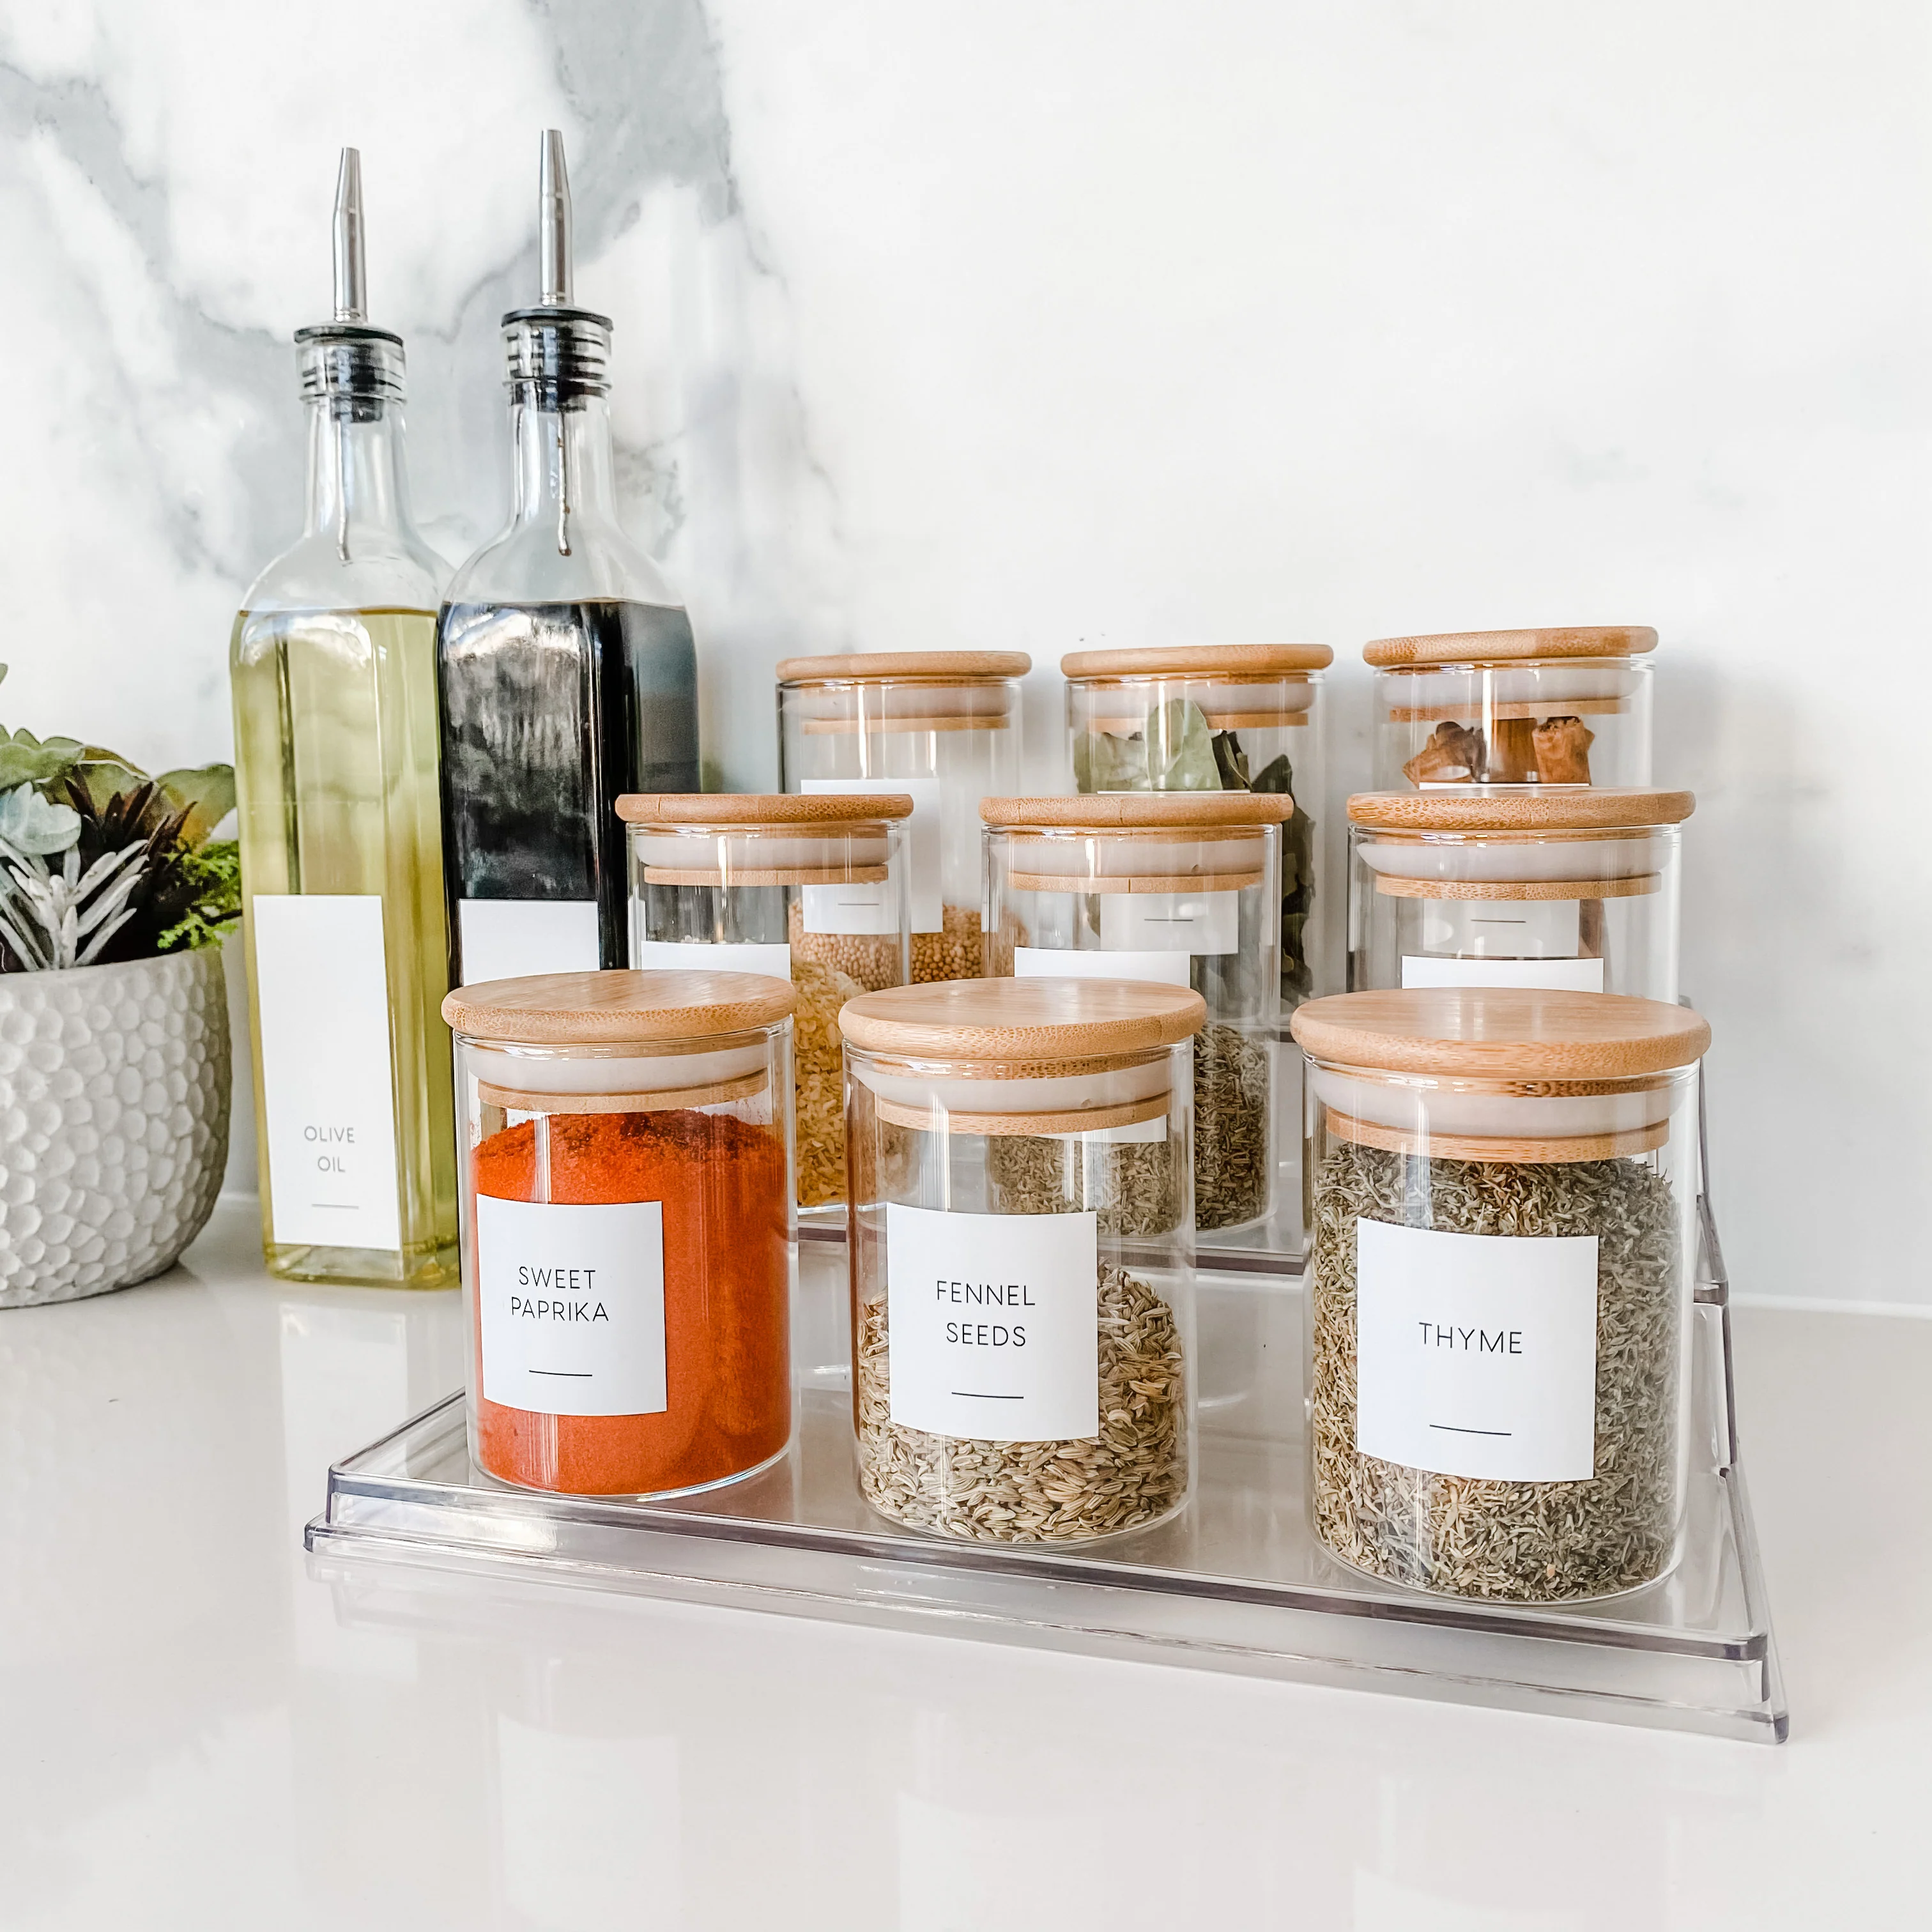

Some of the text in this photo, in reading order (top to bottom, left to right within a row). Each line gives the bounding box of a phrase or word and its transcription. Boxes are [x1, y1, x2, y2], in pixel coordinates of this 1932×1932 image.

[304, 1126, 355, 1144] OLIVE
[318, 1156, 346, 1173] OIL
[519, 1266, 596, 1289] SWEET
[937, 1280, 1036, 1307] FENNEL
[511, 1296, 609, 1322] PAPRIKA
[946, 1322, 1026, 1347] SEEDS
[1418, 1322, 1522, 1354] THYME
